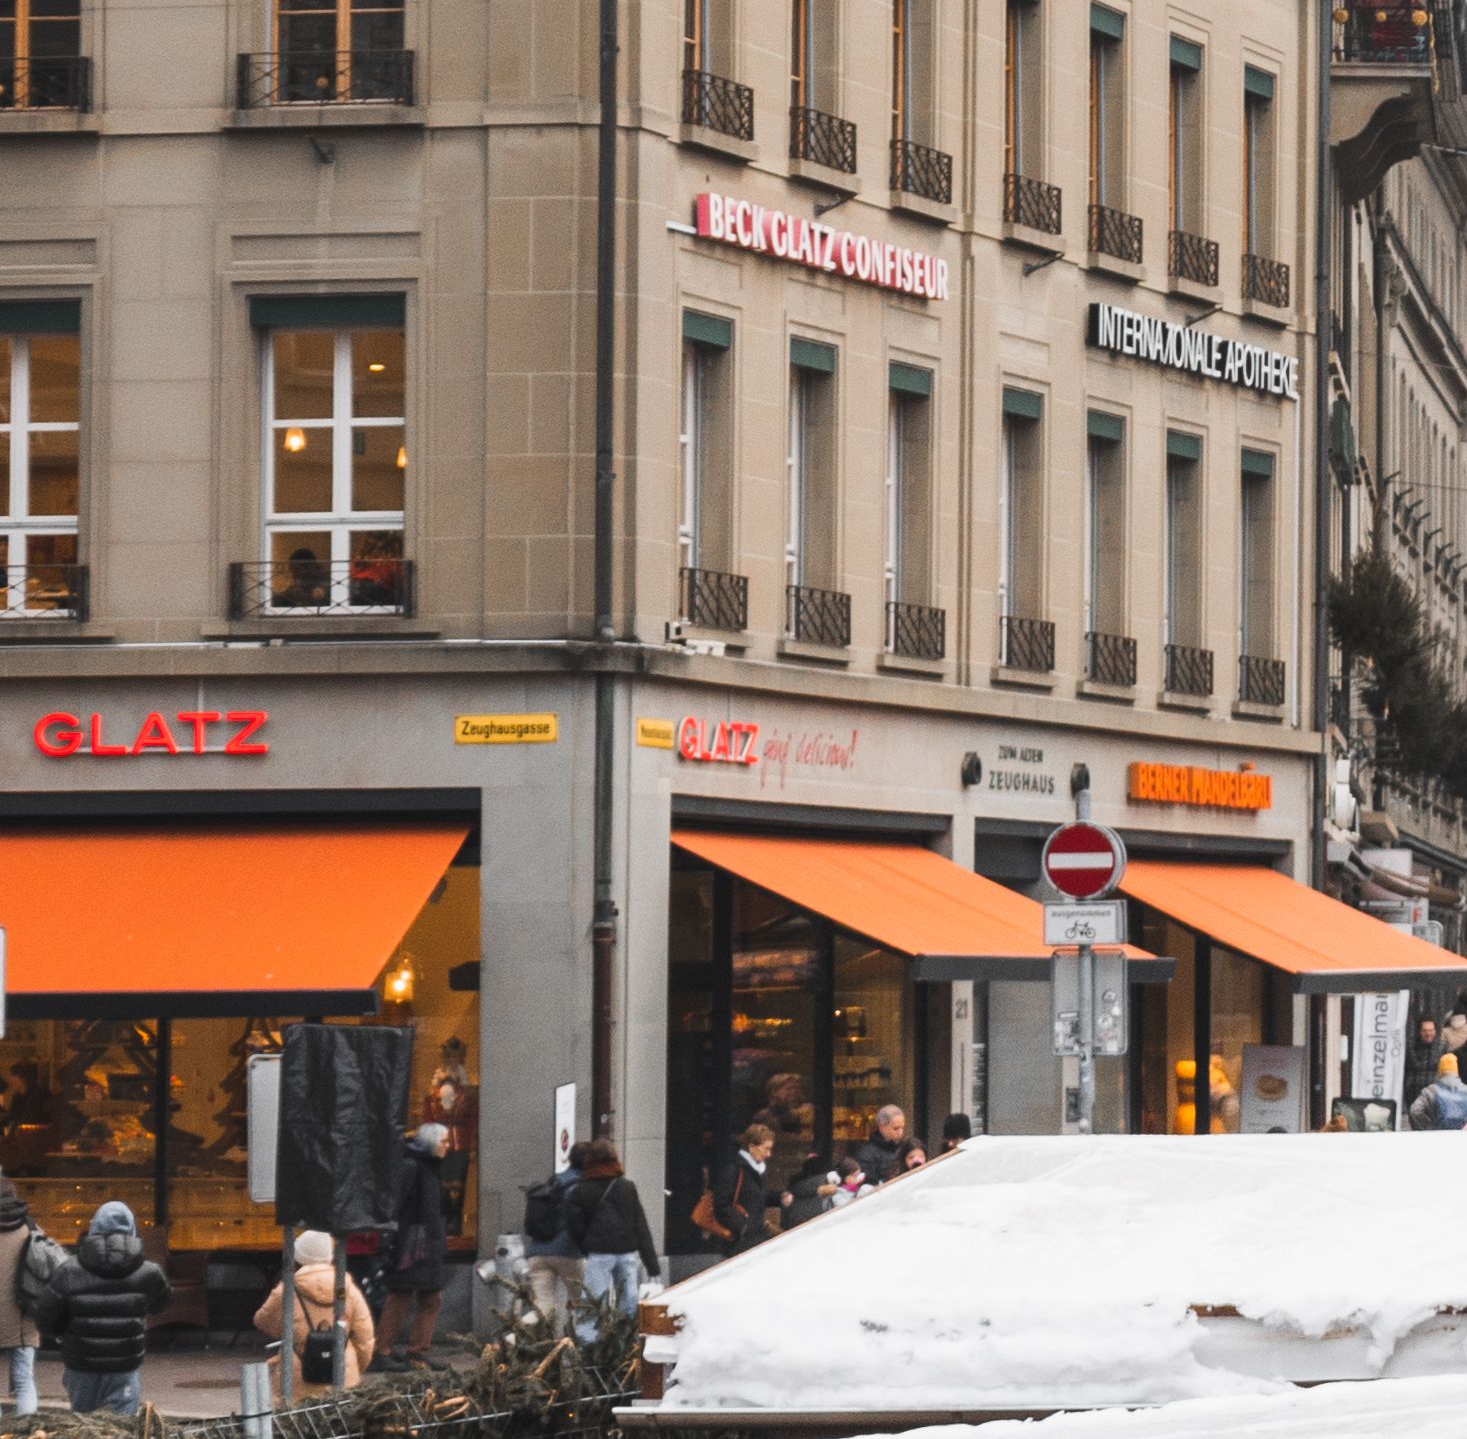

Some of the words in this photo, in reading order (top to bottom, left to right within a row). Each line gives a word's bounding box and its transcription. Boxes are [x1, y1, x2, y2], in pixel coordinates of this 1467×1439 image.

[709, 192, 767, 250] BECK
[770, 210, 837, 270] GLATZ
[840, 232, 950, 300] CONFISEUR
[1224, 340, 1299, 396] APOTHEKE
[33, 711, 269, 757] GLATZ
[461, 720, 550, 739] Zeughausgasse
[680, 716, 760, 765] GLATZ
[988, 770, 1055, 795] ZEUGHAUS
[1137, 762, 1189, 803] BERNER
